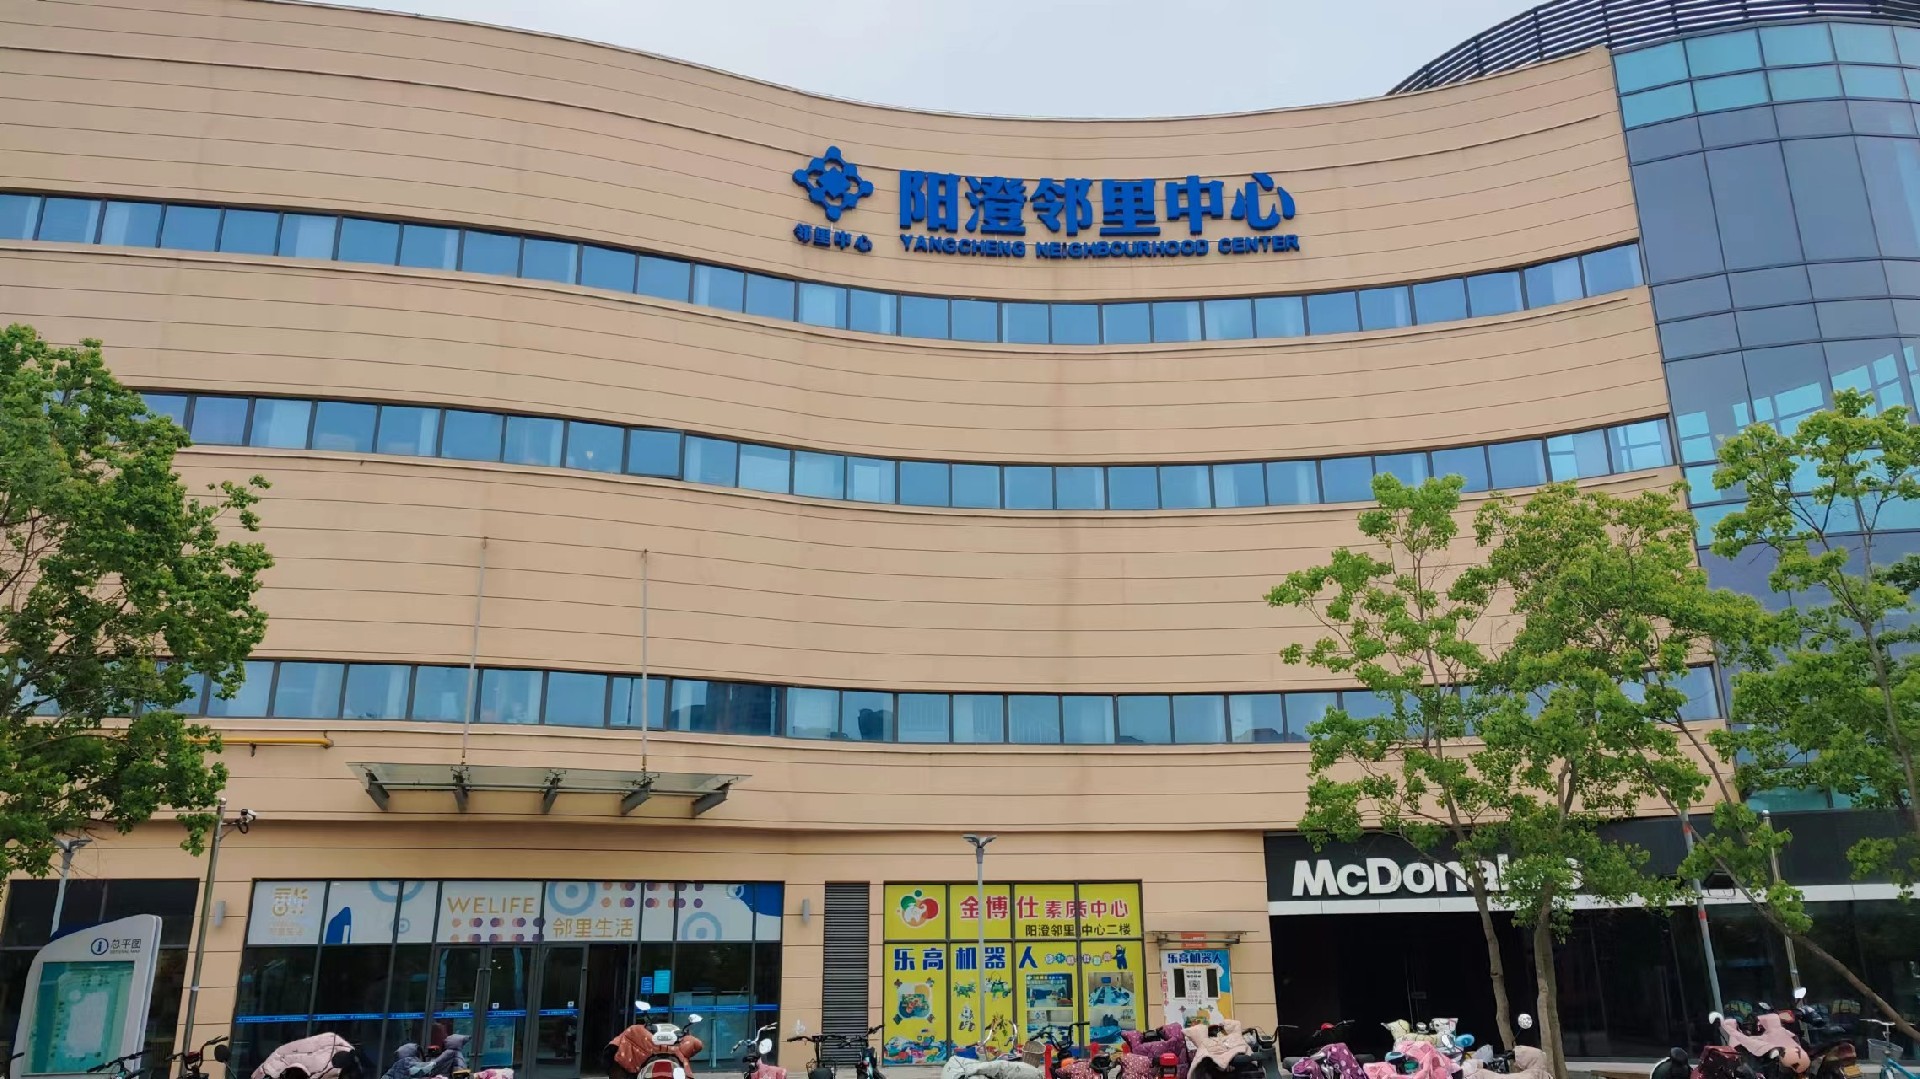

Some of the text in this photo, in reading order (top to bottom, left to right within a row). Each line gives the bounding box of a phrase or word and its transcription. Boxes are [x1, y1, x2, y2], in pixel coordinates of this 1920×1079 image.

[900, 170, 1295, 236] 阳澄邻里中心
[792, 222, 873, 253] 邻里中心
[900, 233, 1300, 260] YANGCHENG NEIGHBOURHOOD CENTER
[447, 896, 535, 914] WELIFE
[960, 895, 1129, 920] 金博仕素质中心
[552, 917, 633, 938] 邻里生活
[1025, 923, 1131, 937] 阳澄邻里中心二楼
[894, 946, 1038, 970] 乐高机器人
[1168, 952, 1222, 964] 乐高机器人
